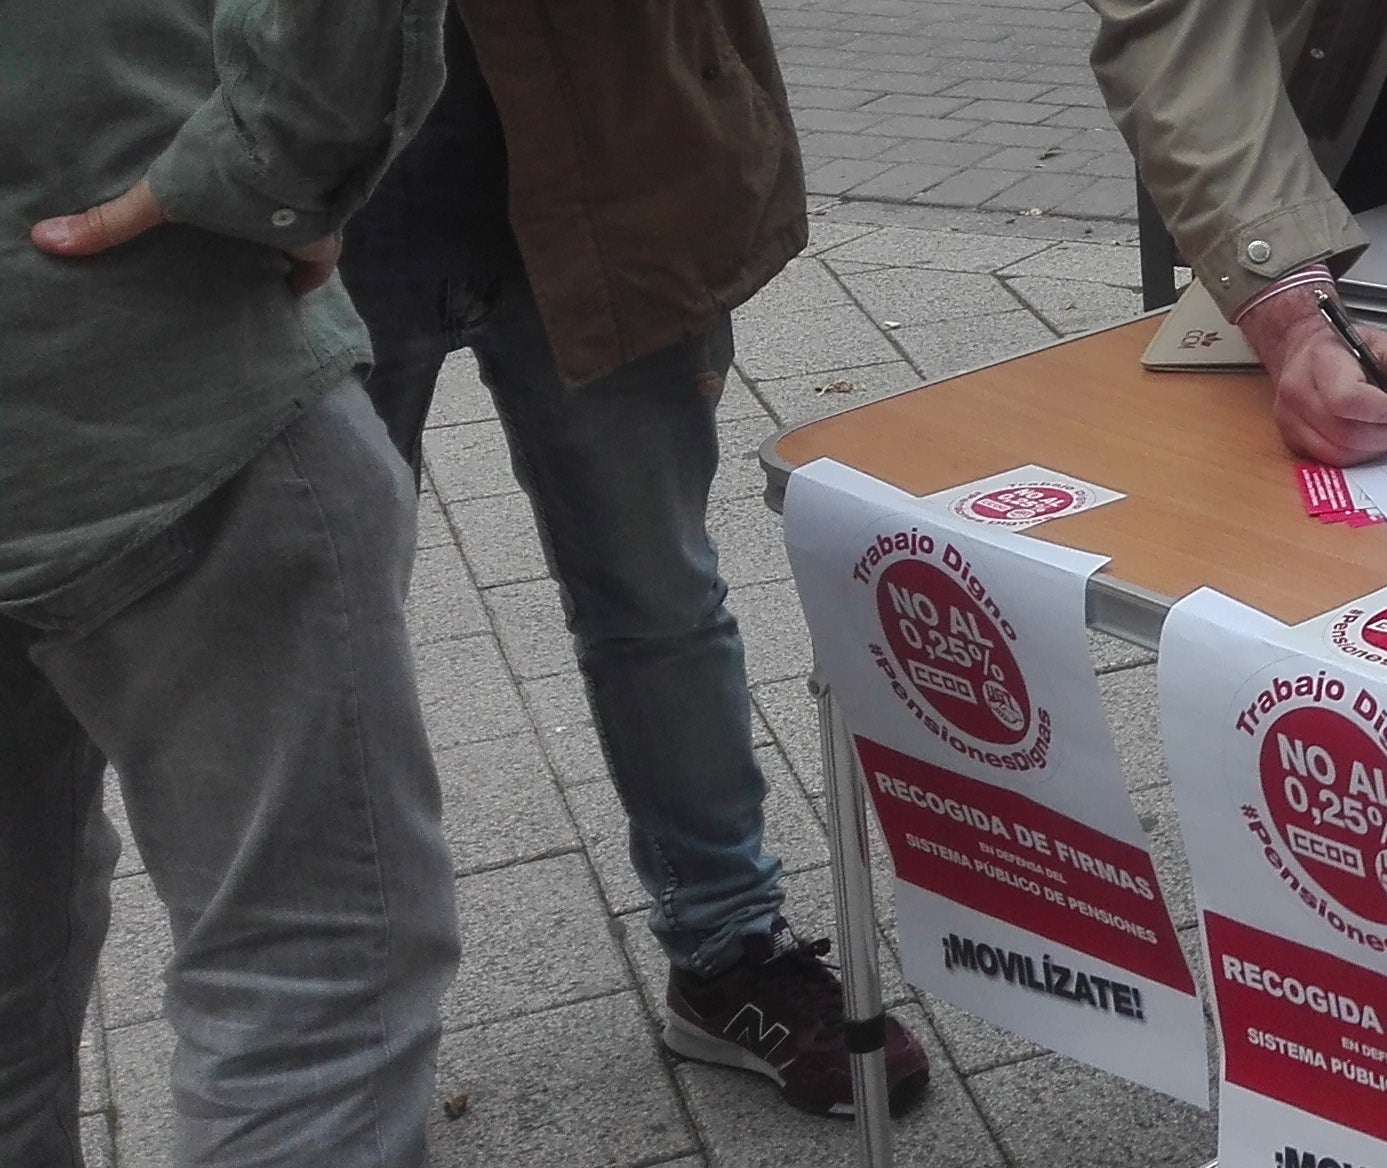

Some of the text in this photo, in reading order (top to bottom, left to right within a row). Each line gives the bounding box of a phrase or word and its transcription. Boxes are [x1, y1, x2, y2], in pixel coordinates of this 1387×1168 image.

[852, 528, 1017, 641] Trabajo Digno
[887, 583, 994, 648] NO AL
[899, 619, 1004, 681] 0,25%
[915, 665, 972, 699] CCOO
[868, 642, 1052, 773] #PensionesDignas
[1235, 670, 1344, 737] Trabajo
[1277, 733, 1336, 786] NO
[874, 771, 1154, 902] RECOGIDA DE FIRMAS
[996, 847, 1044, 876] DEFENSA
[1045, 867, 1068, 884] DEL
[1293, 831, 1360, 872] CCOO
[905, 832, 1159, 946] SISTEMA PÚBLICO DE PENSIONES
[942, 933, 1145, 1020] ¡MOVILÍZATE!
[1221, 953, 1385, 1036] RECOGIDA
[1247, 1026, 1327, 1072] SISTEMA
[1341, 1036, 1361, 1055] EN
